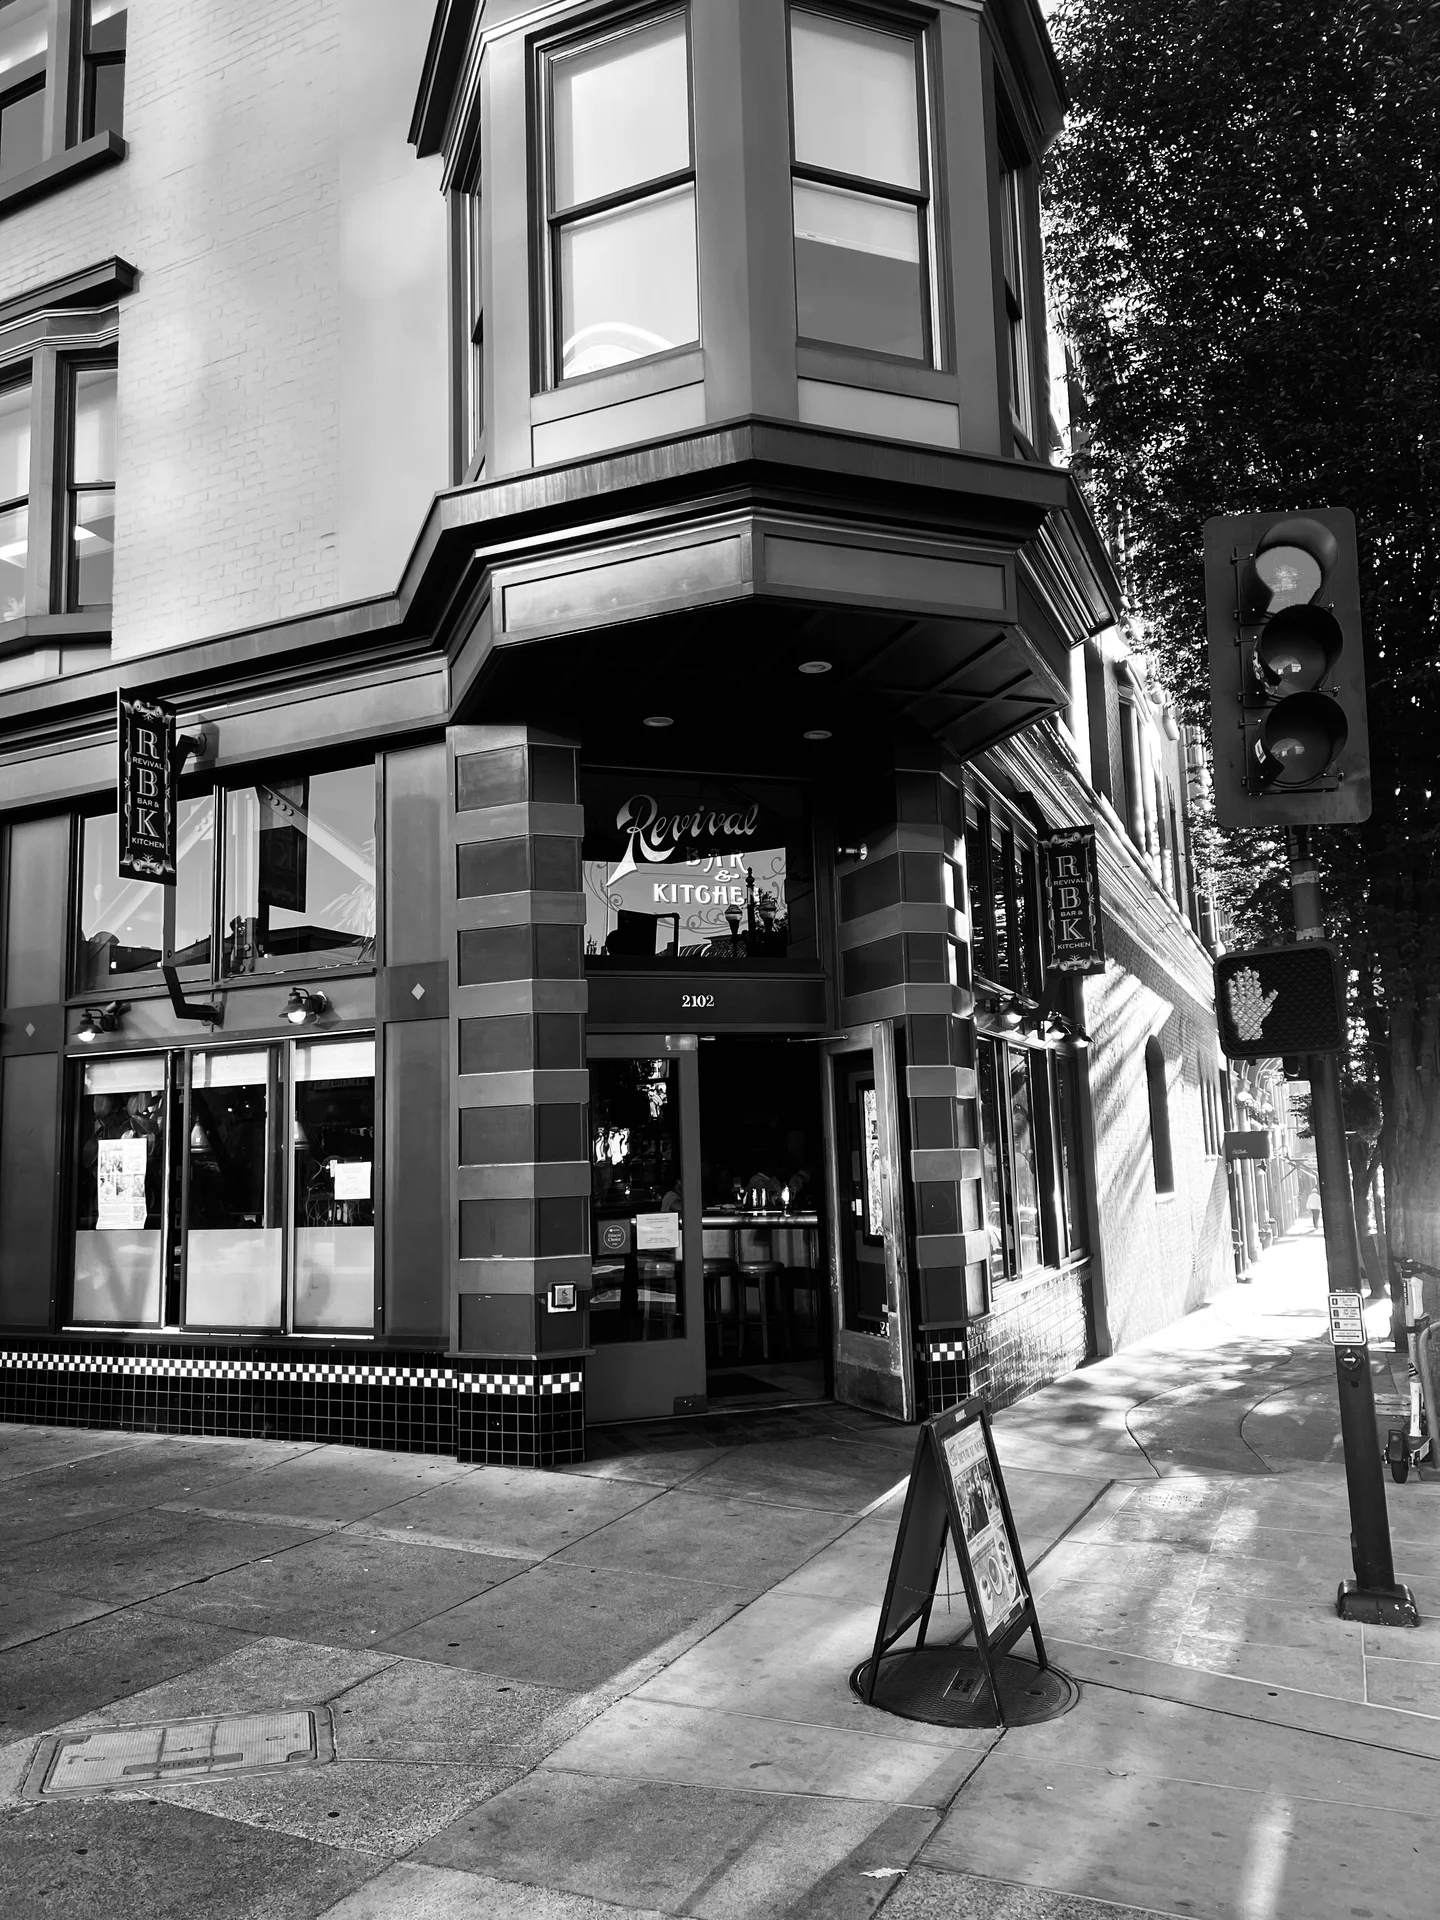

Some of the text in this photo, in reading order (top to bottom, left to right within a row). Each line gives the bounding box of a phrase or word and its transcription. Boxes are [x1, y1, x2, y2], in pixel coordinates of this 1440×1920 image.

[136, 727, 160, 759] R
[132, 756, 164, 770] REVIVAL
[136, 767, 159, 797] B
[137, 797, 160, 808] BAR &
[136, 807, 160, 838] K
[131, 836, 165, 849] KITCHEN
[606, 794, 759, 886] Revival
[1055, 855, 1081, 878] R
[715, 870, 740, 882] &
[1053, 878, 1086, 886] REVIVAL
[1058, 886, 1082, 910] B
[1060, 917, 1086, 941] K
[1057, 941, 1091, 950] KITCHEN
[681, 994, 715, 1008] 2102
